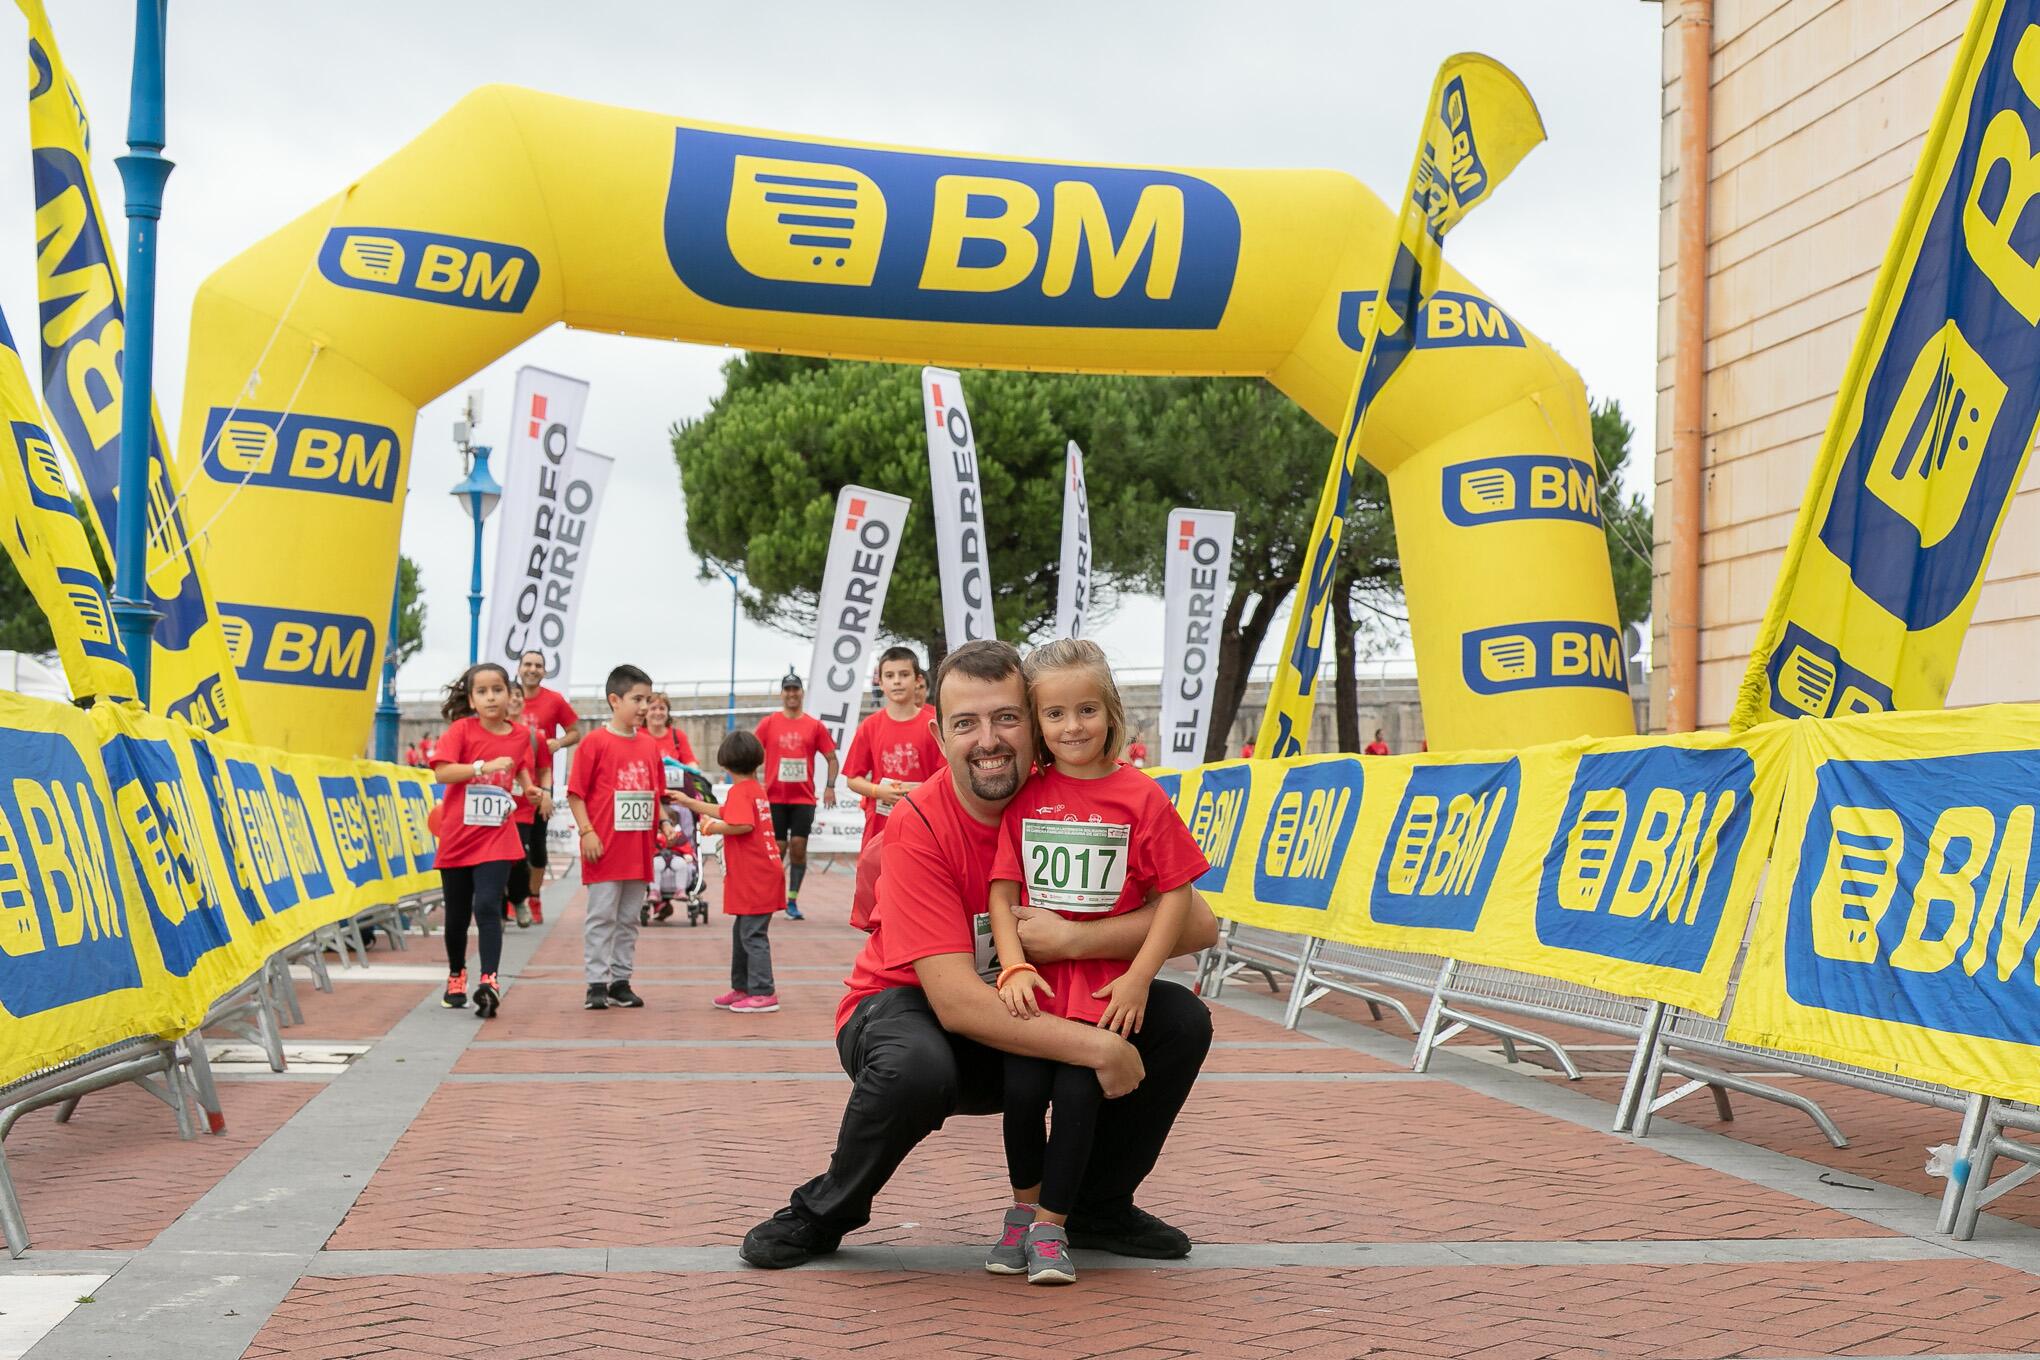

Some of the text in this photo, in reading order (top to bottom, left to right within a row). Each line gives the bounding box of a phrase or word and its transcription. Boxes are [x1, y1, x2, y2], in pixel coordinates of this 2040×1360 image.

[1963, 23, 2040, 328] B
[414, 243, 525, 304] BM
[919, 174, 1186, 300] BM
[1426, 298, 1510, 340] BM
[288, 427, 392, 490] BM
[1529, 465, 1599, 518] BM
[539, 479, 593, 680] CORREO
[1071, 478, 1088, 639] ORREO
[263, 620, 367, 679] BM
[827, 519, 890, 693] CORREO
[1172, 536, 1221, 753] EL CORREO
[1550, 631, 1622, 682] BM
[621, 802, 652, 821] 203
[1203, 787, 1245, 868] BM
[1288, 786, 1351, 880] BM
[1418, 786, 1507, 897] BM
[1609, 787, 1736, 926] BM
[13, 777, 123, 947] BM
[1031, 844, 1117, 890] 2017
